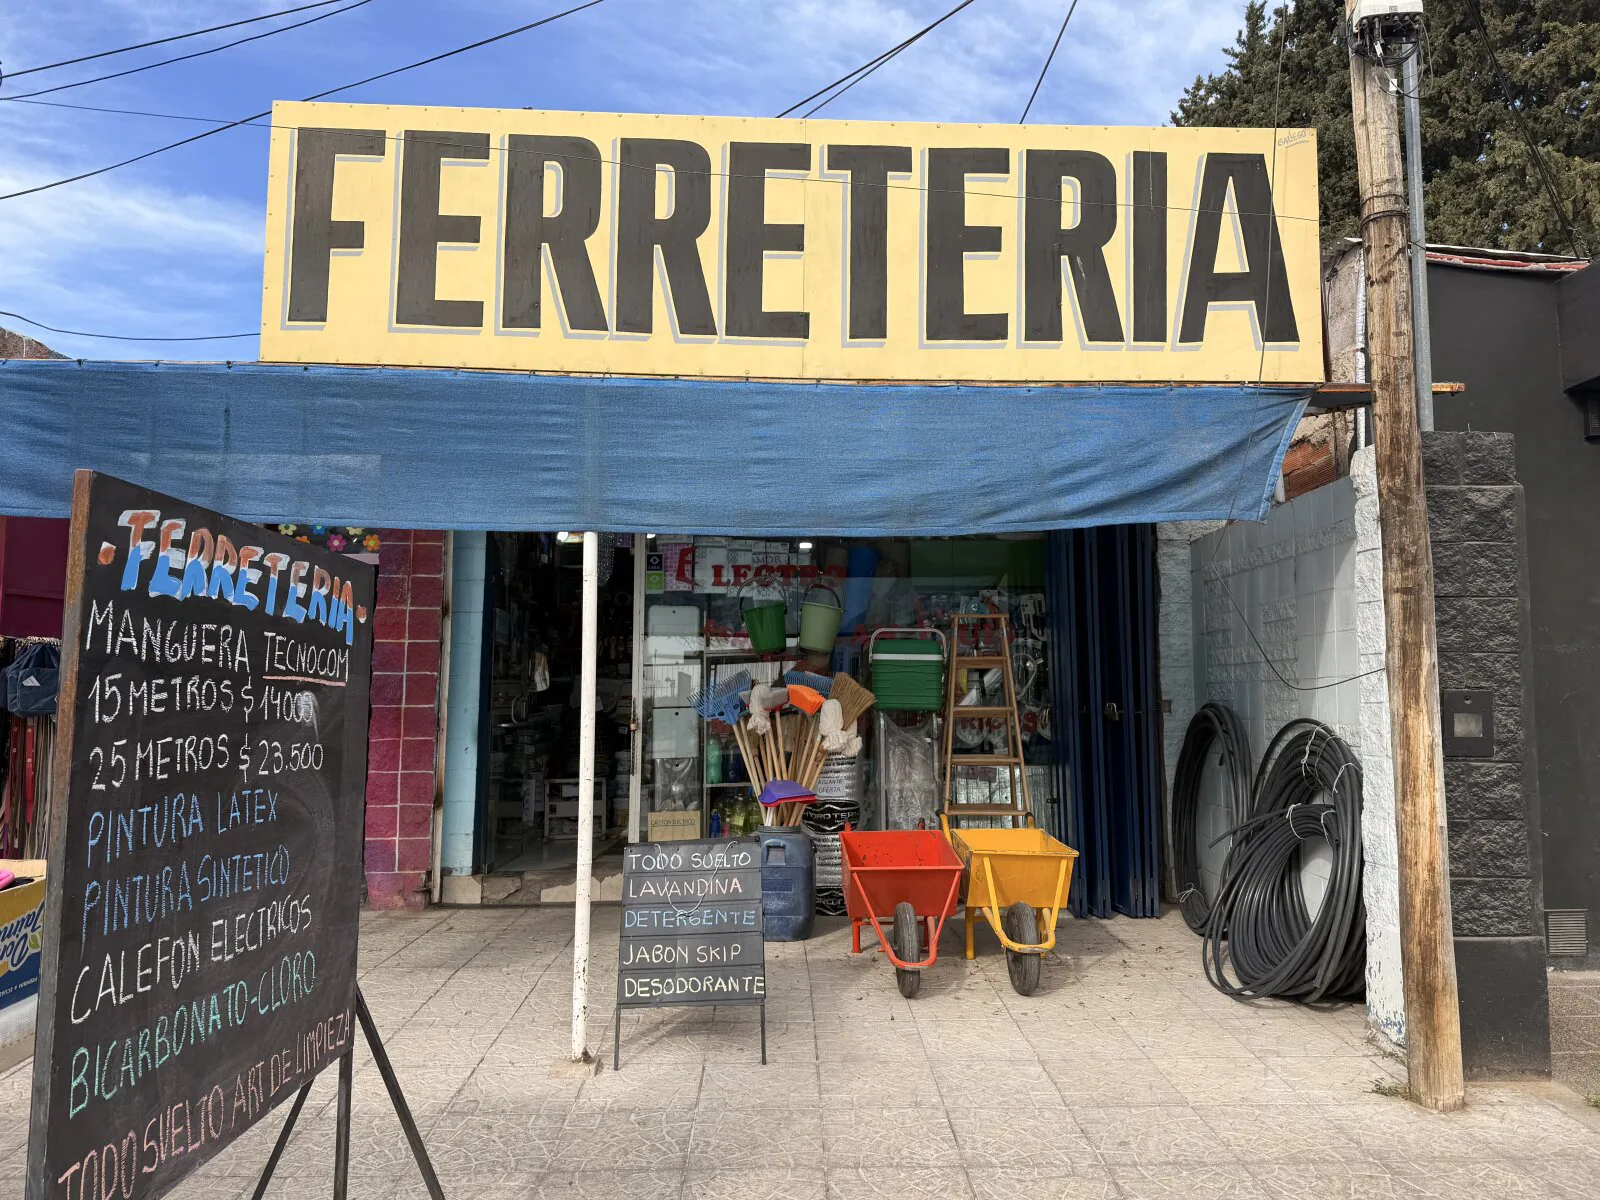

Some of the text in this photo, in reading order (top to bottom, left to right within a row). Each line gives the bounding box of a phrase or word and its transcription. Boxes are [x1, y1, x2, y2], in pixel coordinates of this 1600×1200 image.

[281, 126, 1300, 350] FERRETERIA
[118, 509, 355, 646] FERRETERIA
[86, 599, 350, 684] MANGUERA TECNOCOM
[88, 673, 122, 724] 15
[129, 674, 234, 716] METROS
[89, 739, 127, 790] 25
[134, 733, 230, 782] METROS
[258, 740, 324, 775] 23.500
[88, 789, 279, 868] PINTURA LATEX
[628, 852, 751, 871] TODO SUELTO
[80, 844, 290, 962] PINTURA SINTETICO
[624, 909, 756, 929] DETERGENTE
[629, 877, 743, 898] LAVANDINA
[71, 894, 312, 1025] CALEFON ELECTRICOS
[623, 943, 742, 965] JABON SKIP
[624, 976, 766, 998] DESODORANTE
[57, 1130, 138, 1200] TODO
[231, 1060, 265, 1130] ART
[269, 1047, 292, 1099] DE
[296, 1007, 351, 1076] LIMPIEZA
